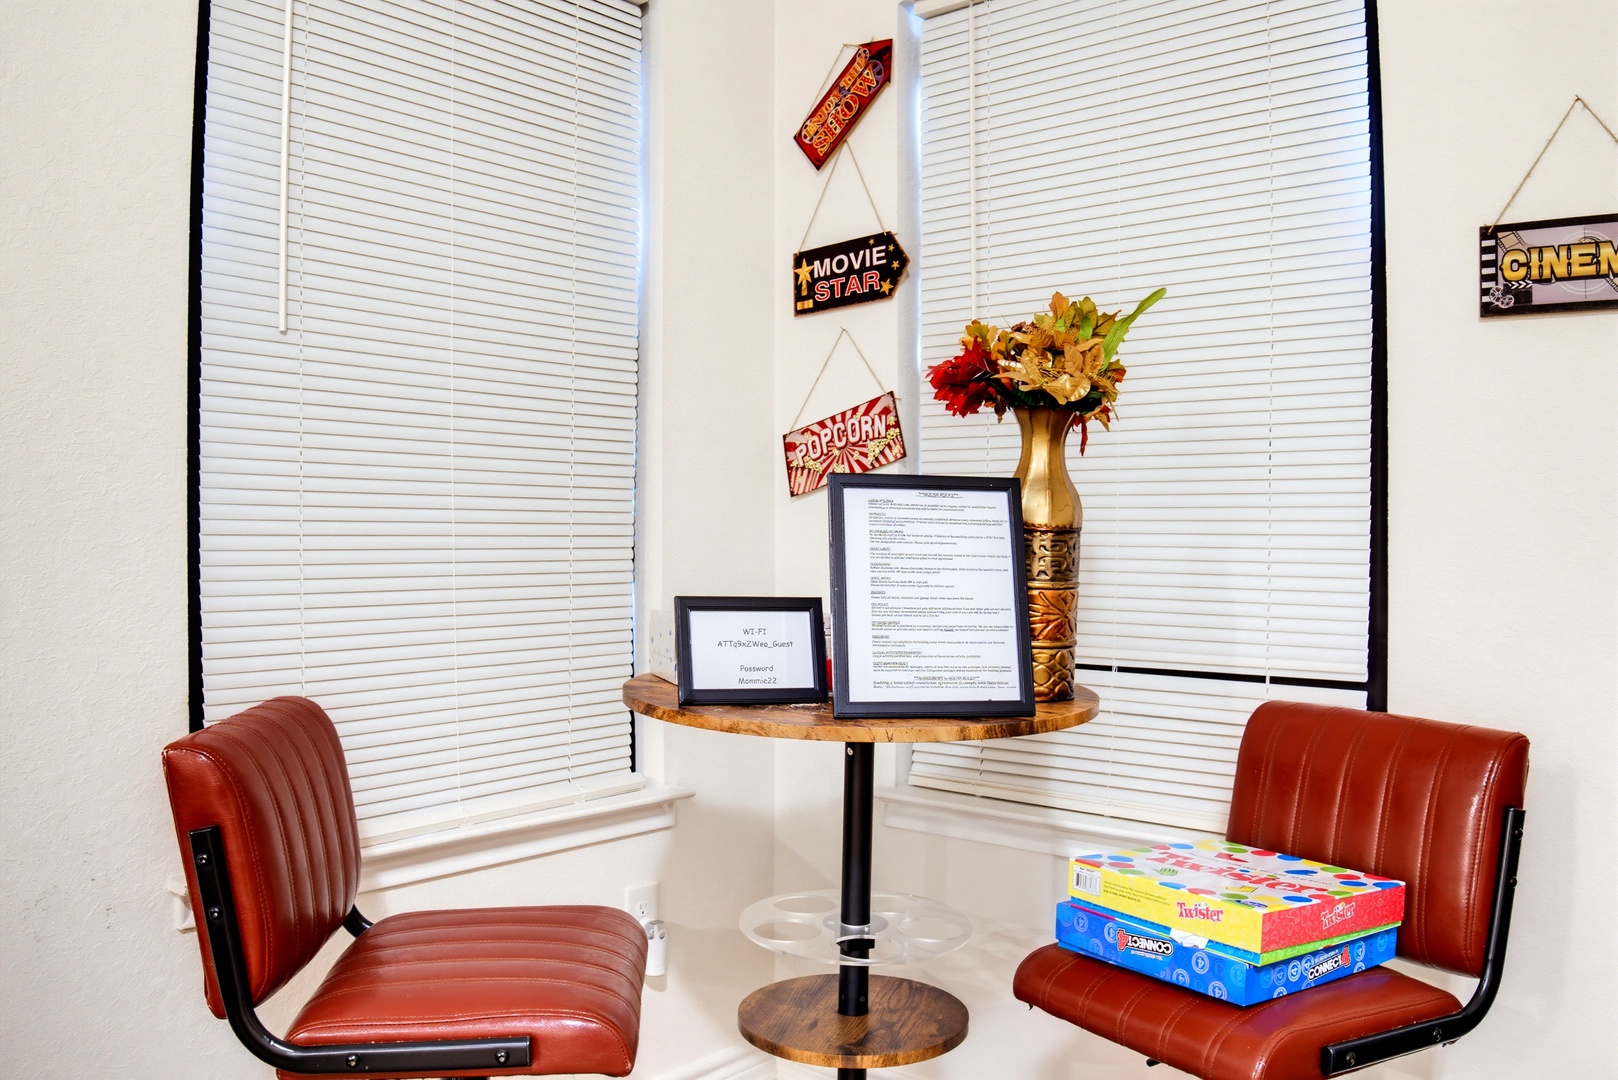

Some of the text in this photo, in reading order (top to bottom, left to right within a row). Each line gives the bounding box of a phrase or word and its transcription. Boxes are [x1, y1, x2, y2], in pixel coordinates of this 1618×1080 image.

[812, 64, 877, 156] SHOW
[813, 245, 887, 278] MOVIE
[814, 270, 881, 302] STAR
[794, 413, 887, 468] POPCORN
[742, 628, 767, 636] WI-FI
[738, 677, 777, 685] Mommie22
[739, 664, 774, 672] Password
[1146, 851, 1329, 894] Twister
[1176, 901, 1224, 922] Twister
[1320, 901, 1356, 929] Twister
[1116, 929, 1129, 951] 4
[1127, 934, 1173, 955] CONNECT
[1307, 953, 1342, 980] CONNECT
[1341, 944, 1351, 967] 4
